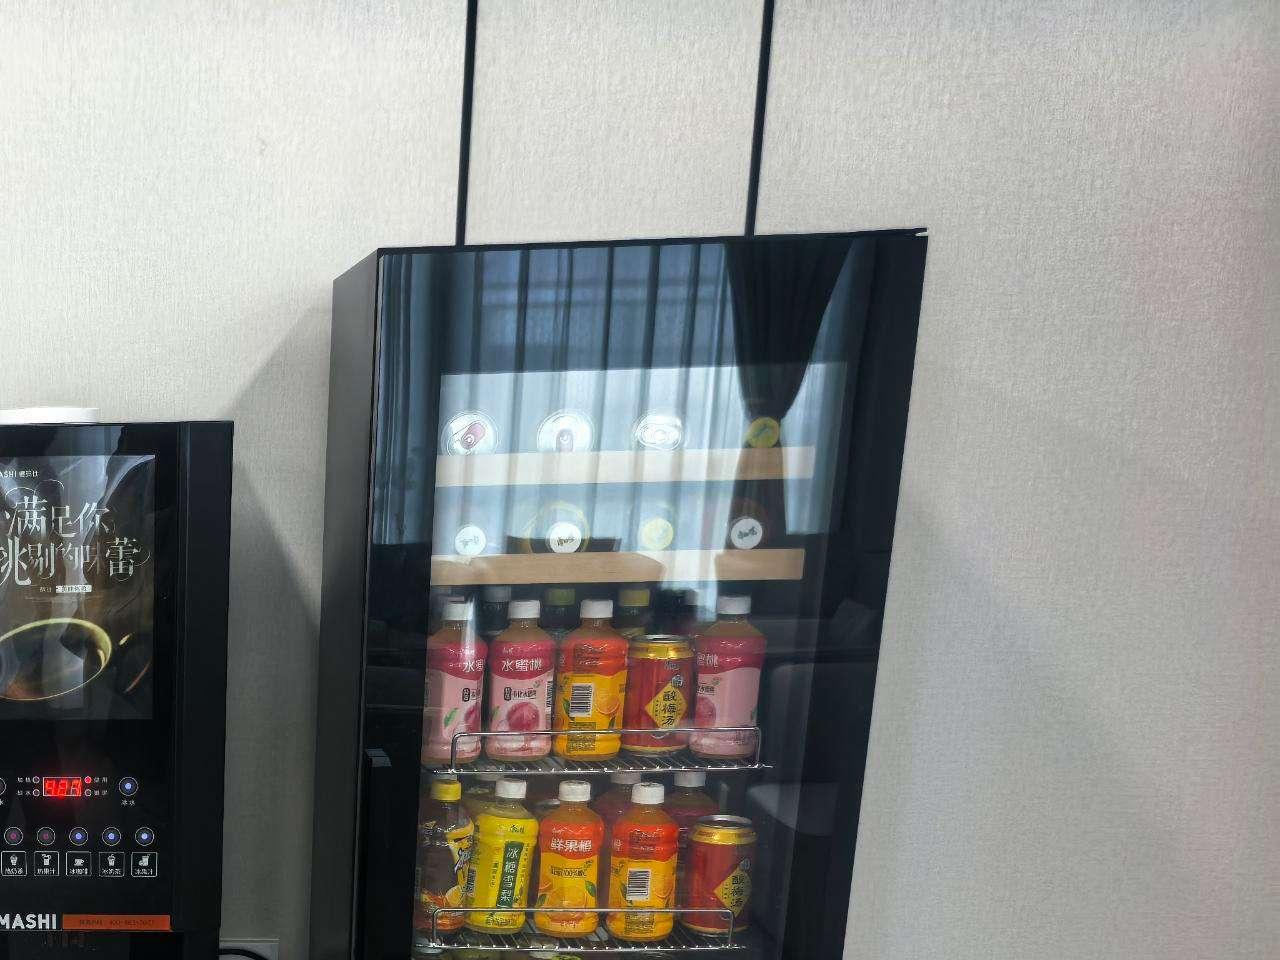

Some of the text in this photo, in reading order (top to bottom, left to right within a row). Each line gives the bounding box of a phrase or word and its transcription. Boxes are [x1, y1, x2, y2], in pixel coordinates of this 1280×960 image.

[4, 495, 111, 538] 满足你
[501, 658, 542, 672] 水蜜桃
